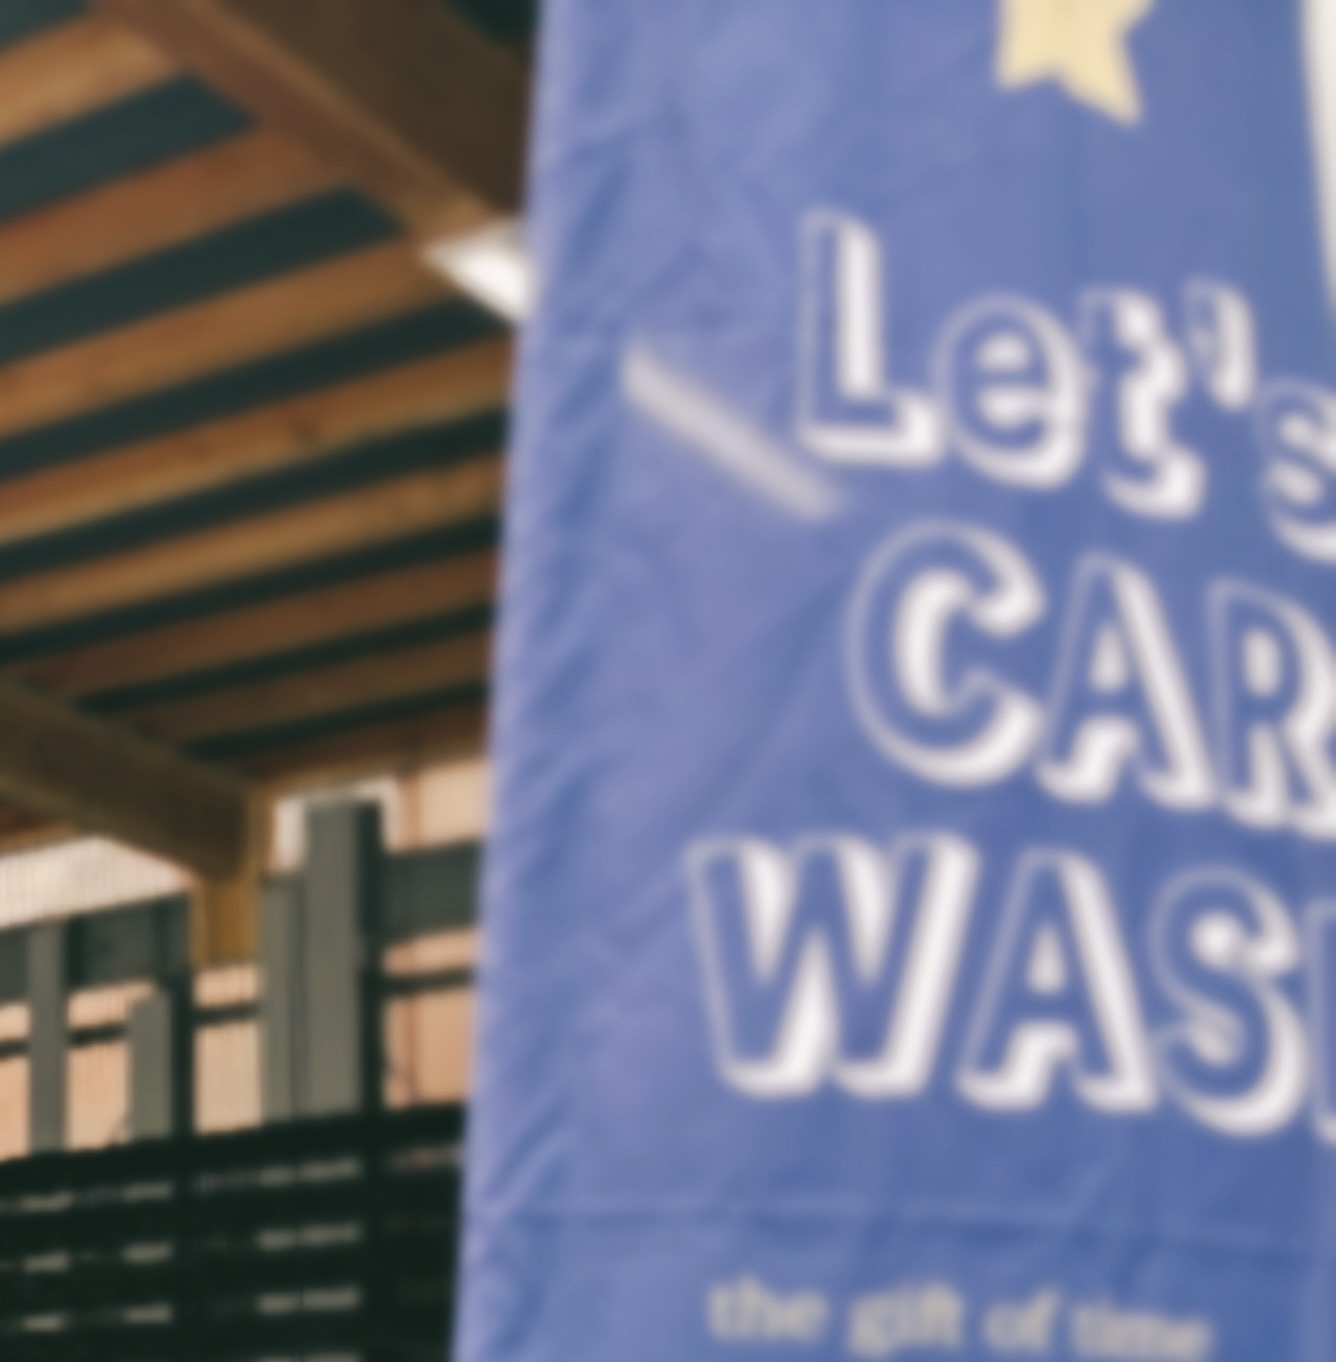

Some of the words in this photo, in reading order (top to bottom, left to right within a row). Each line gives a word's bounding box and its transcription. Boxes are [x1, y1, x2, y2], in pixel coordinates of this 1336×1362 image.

[846, 517, 1336, 838] CAR
[685, 828, 1336, 1146] WAS
[707, 1276, 827, 1344] the
[847, 1281, 965, 1360] gift
[982, 1286, 1059, 1356] of
